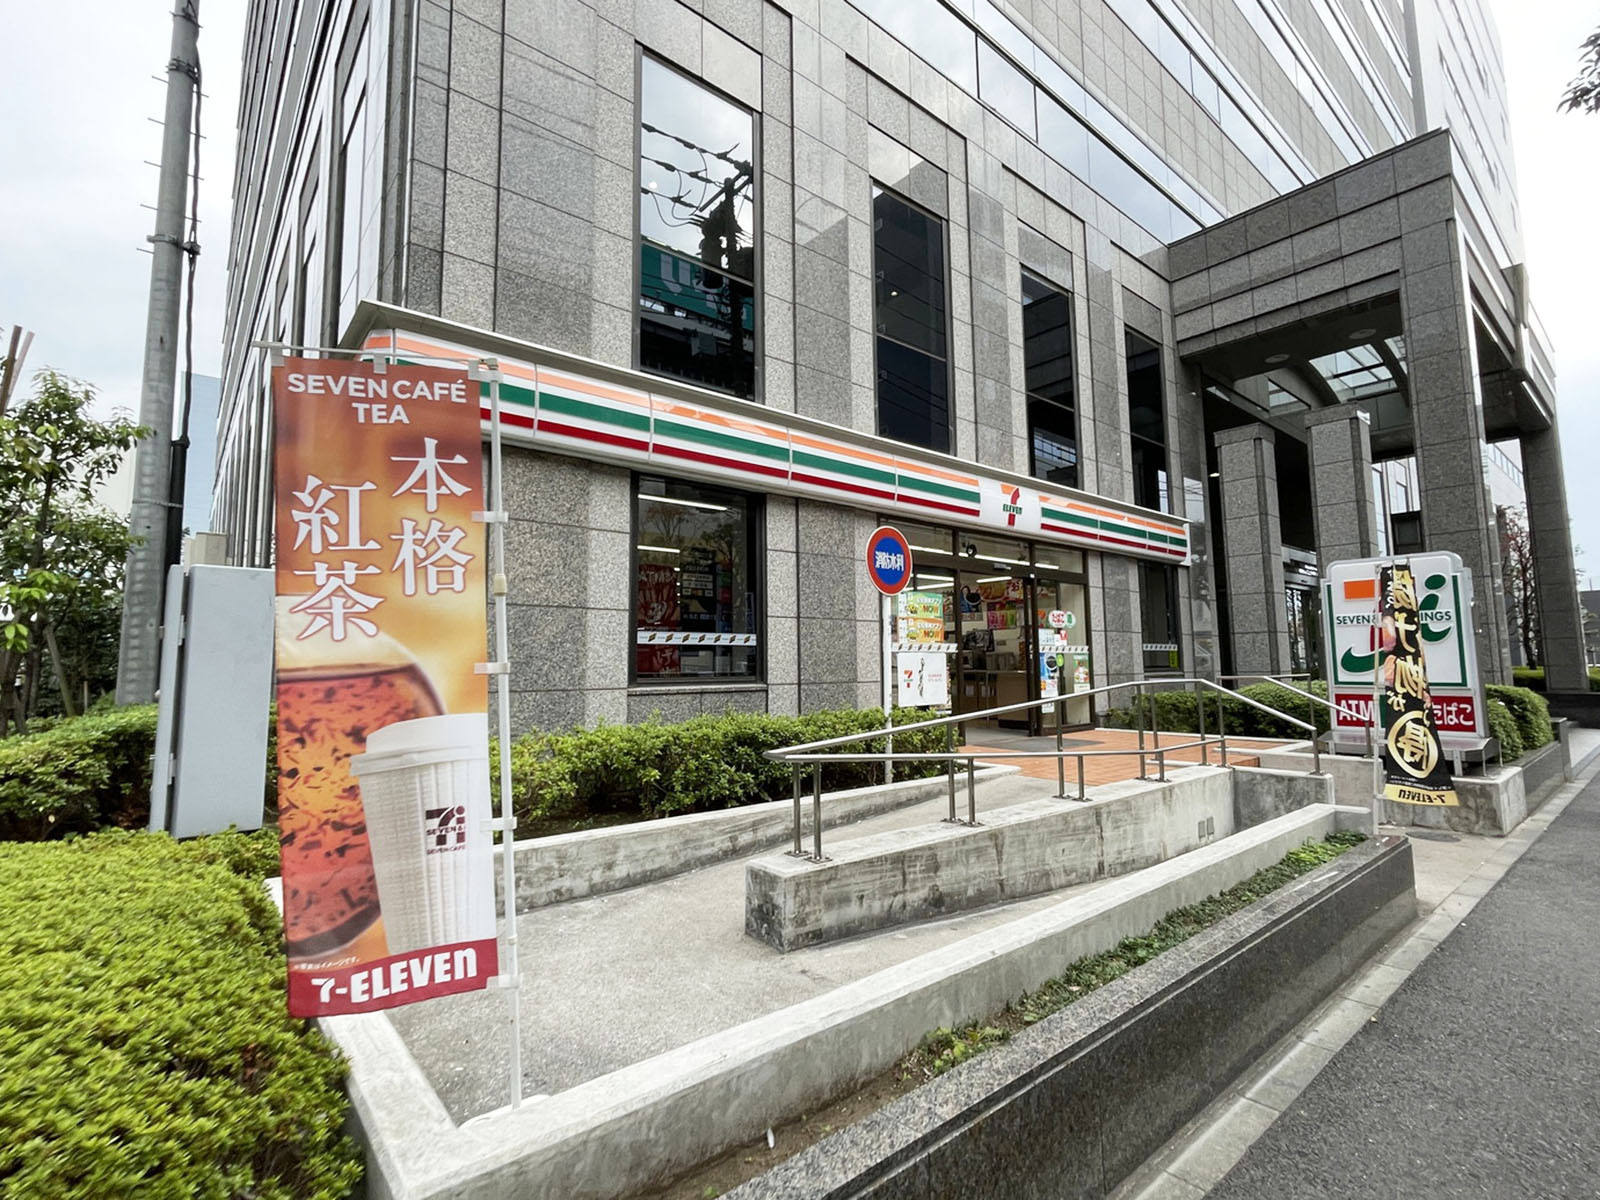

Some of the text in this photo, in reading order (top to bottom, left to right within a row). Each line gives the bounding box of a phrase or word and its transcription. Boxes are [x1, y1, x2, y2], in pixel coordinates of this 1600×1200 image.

[287, 373, 467, 404] SEVEN CAFÉ
[352, 402, 410, 425] TEA
[390, 437, 475, 597] 本格
[290, 474, 385, 642] 紅茶
[1339, 699, 1374, 722] ATM
